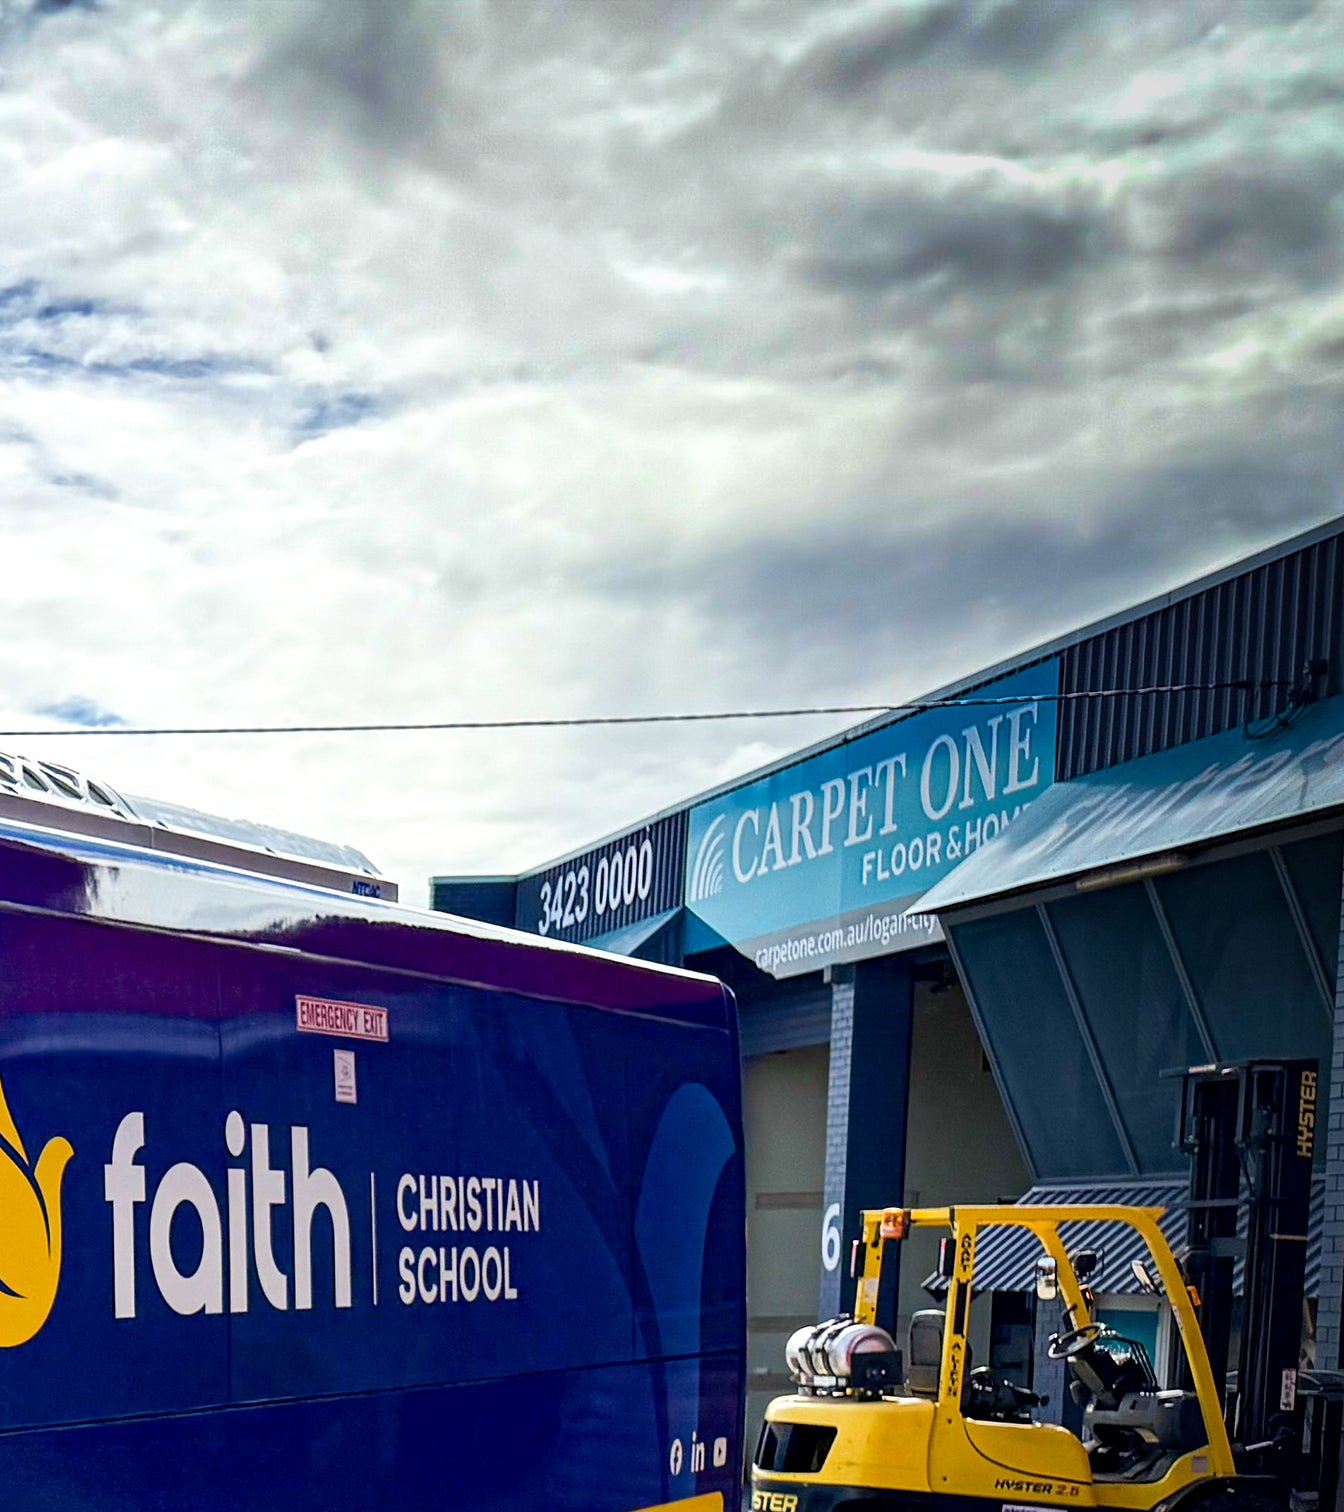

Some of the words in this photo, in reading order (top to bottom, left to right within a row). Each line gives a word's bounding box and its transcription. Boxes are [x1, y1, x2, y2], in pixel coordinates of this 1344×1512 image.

[732, 752, 906, 883] CARPET
[920, 702, 1039, 820] ONE
[862, 831, 942, 885] FLOOR
[946, 825, 962, 860] &
[538, 865, 589, 936] 3423
[595, 839, 652, 915] 0000
[300, 1001, 358, 1032] EMERGENCY
[364, 1011, 383, 1036] EXIT
[1297, 1071, 1317, 1158] HYSTER
[104, 1110, 352, 1318] faith
[397, 1173, 540, 1233] CHRISTIAN
[822, 1203, 841, 1272] 6
[398, 1247, 518, 1305] SCHOOL
[995, 1478, 1053, 1494] HYSTER
